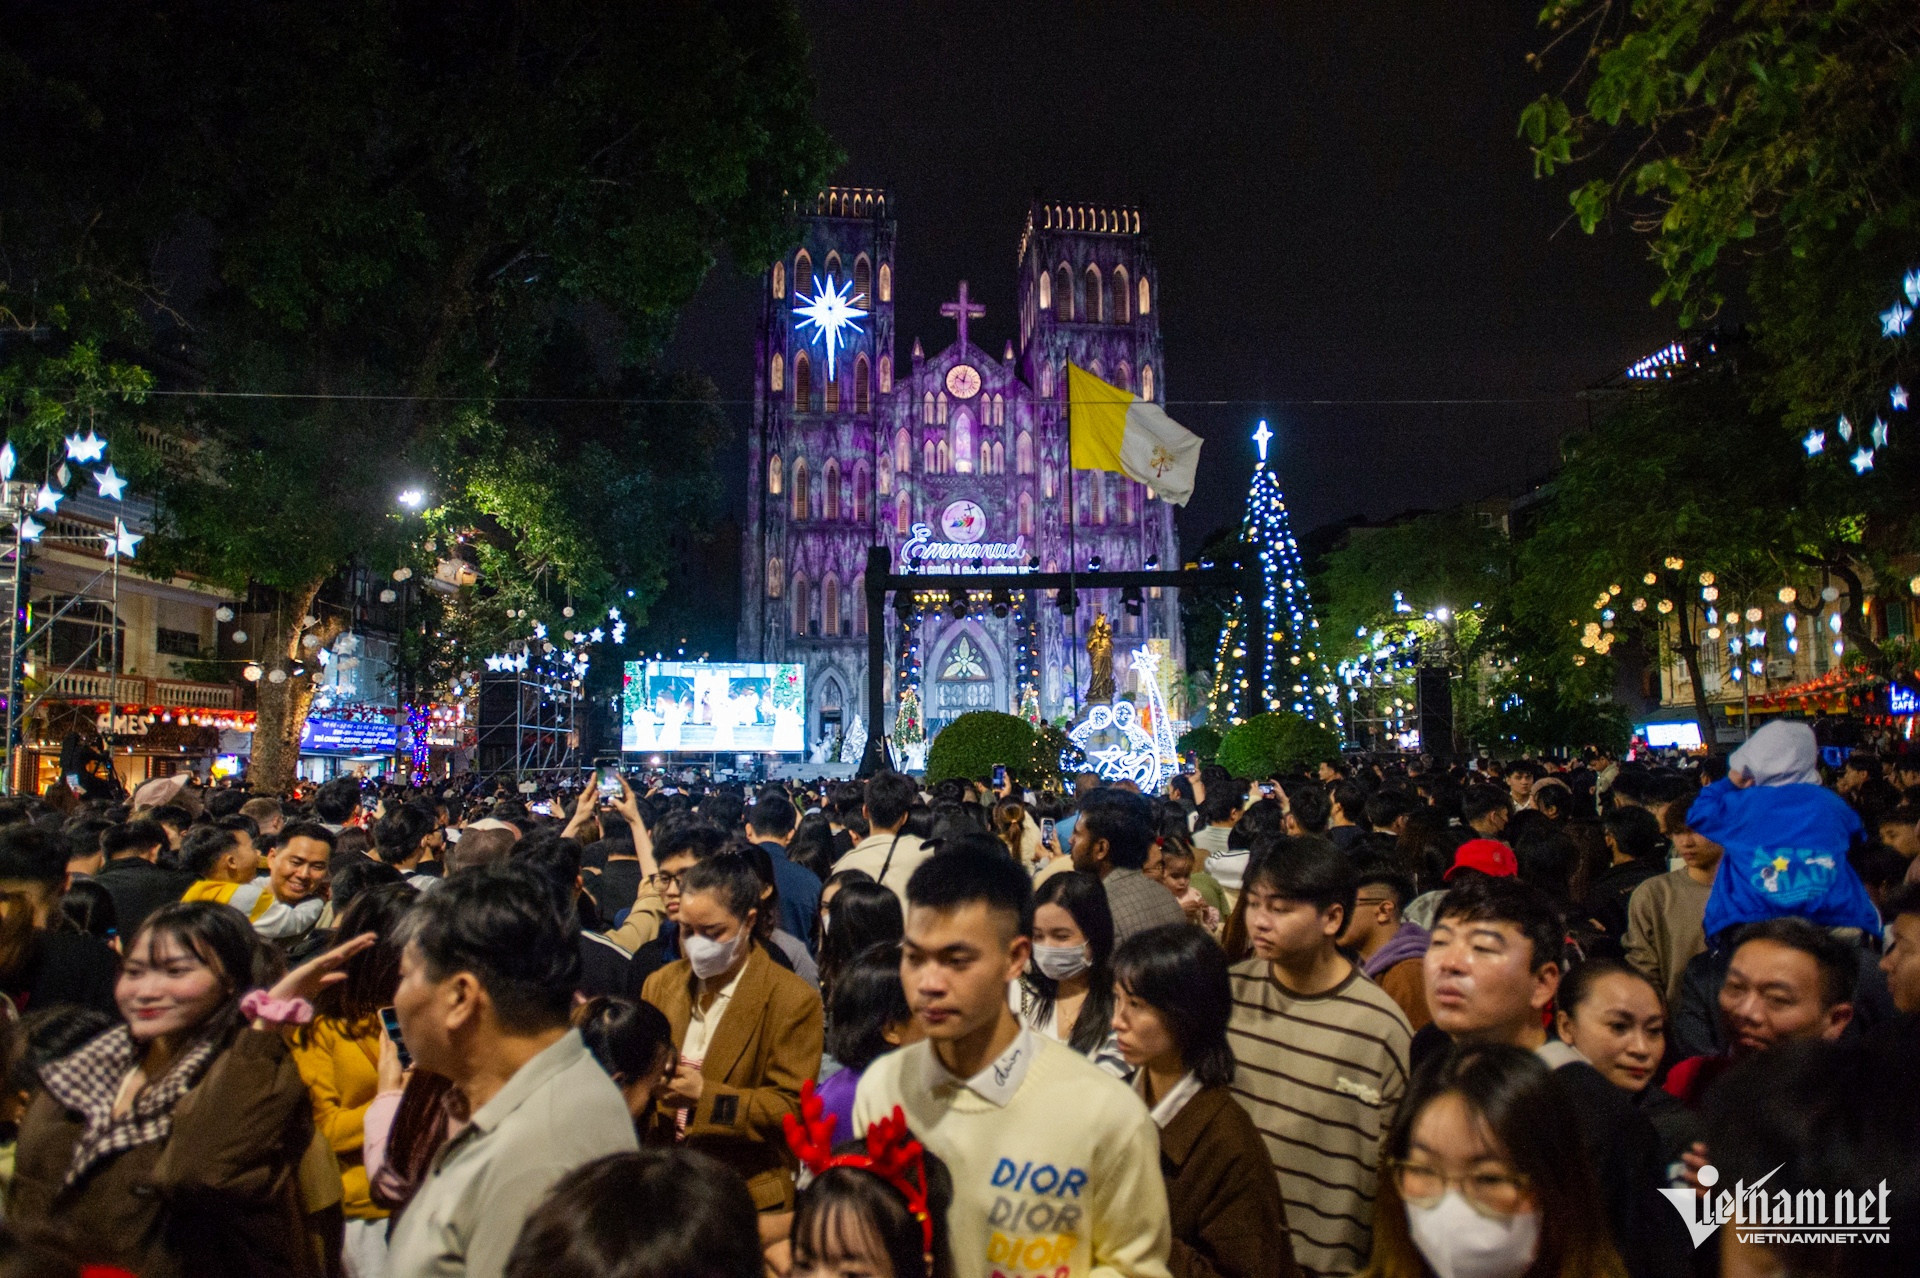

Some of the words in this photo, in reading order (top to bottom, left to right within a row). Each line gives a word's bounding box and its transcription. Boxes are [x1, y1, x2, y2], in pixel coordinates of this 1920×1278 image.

[900, 522, 1027, 564] Emmanuel
[990, 1157, 1089, 1198] DIOR
[987, 1195, 1083, 1232] DIOR
[986, 1231, 1079, 1270] DIOR
